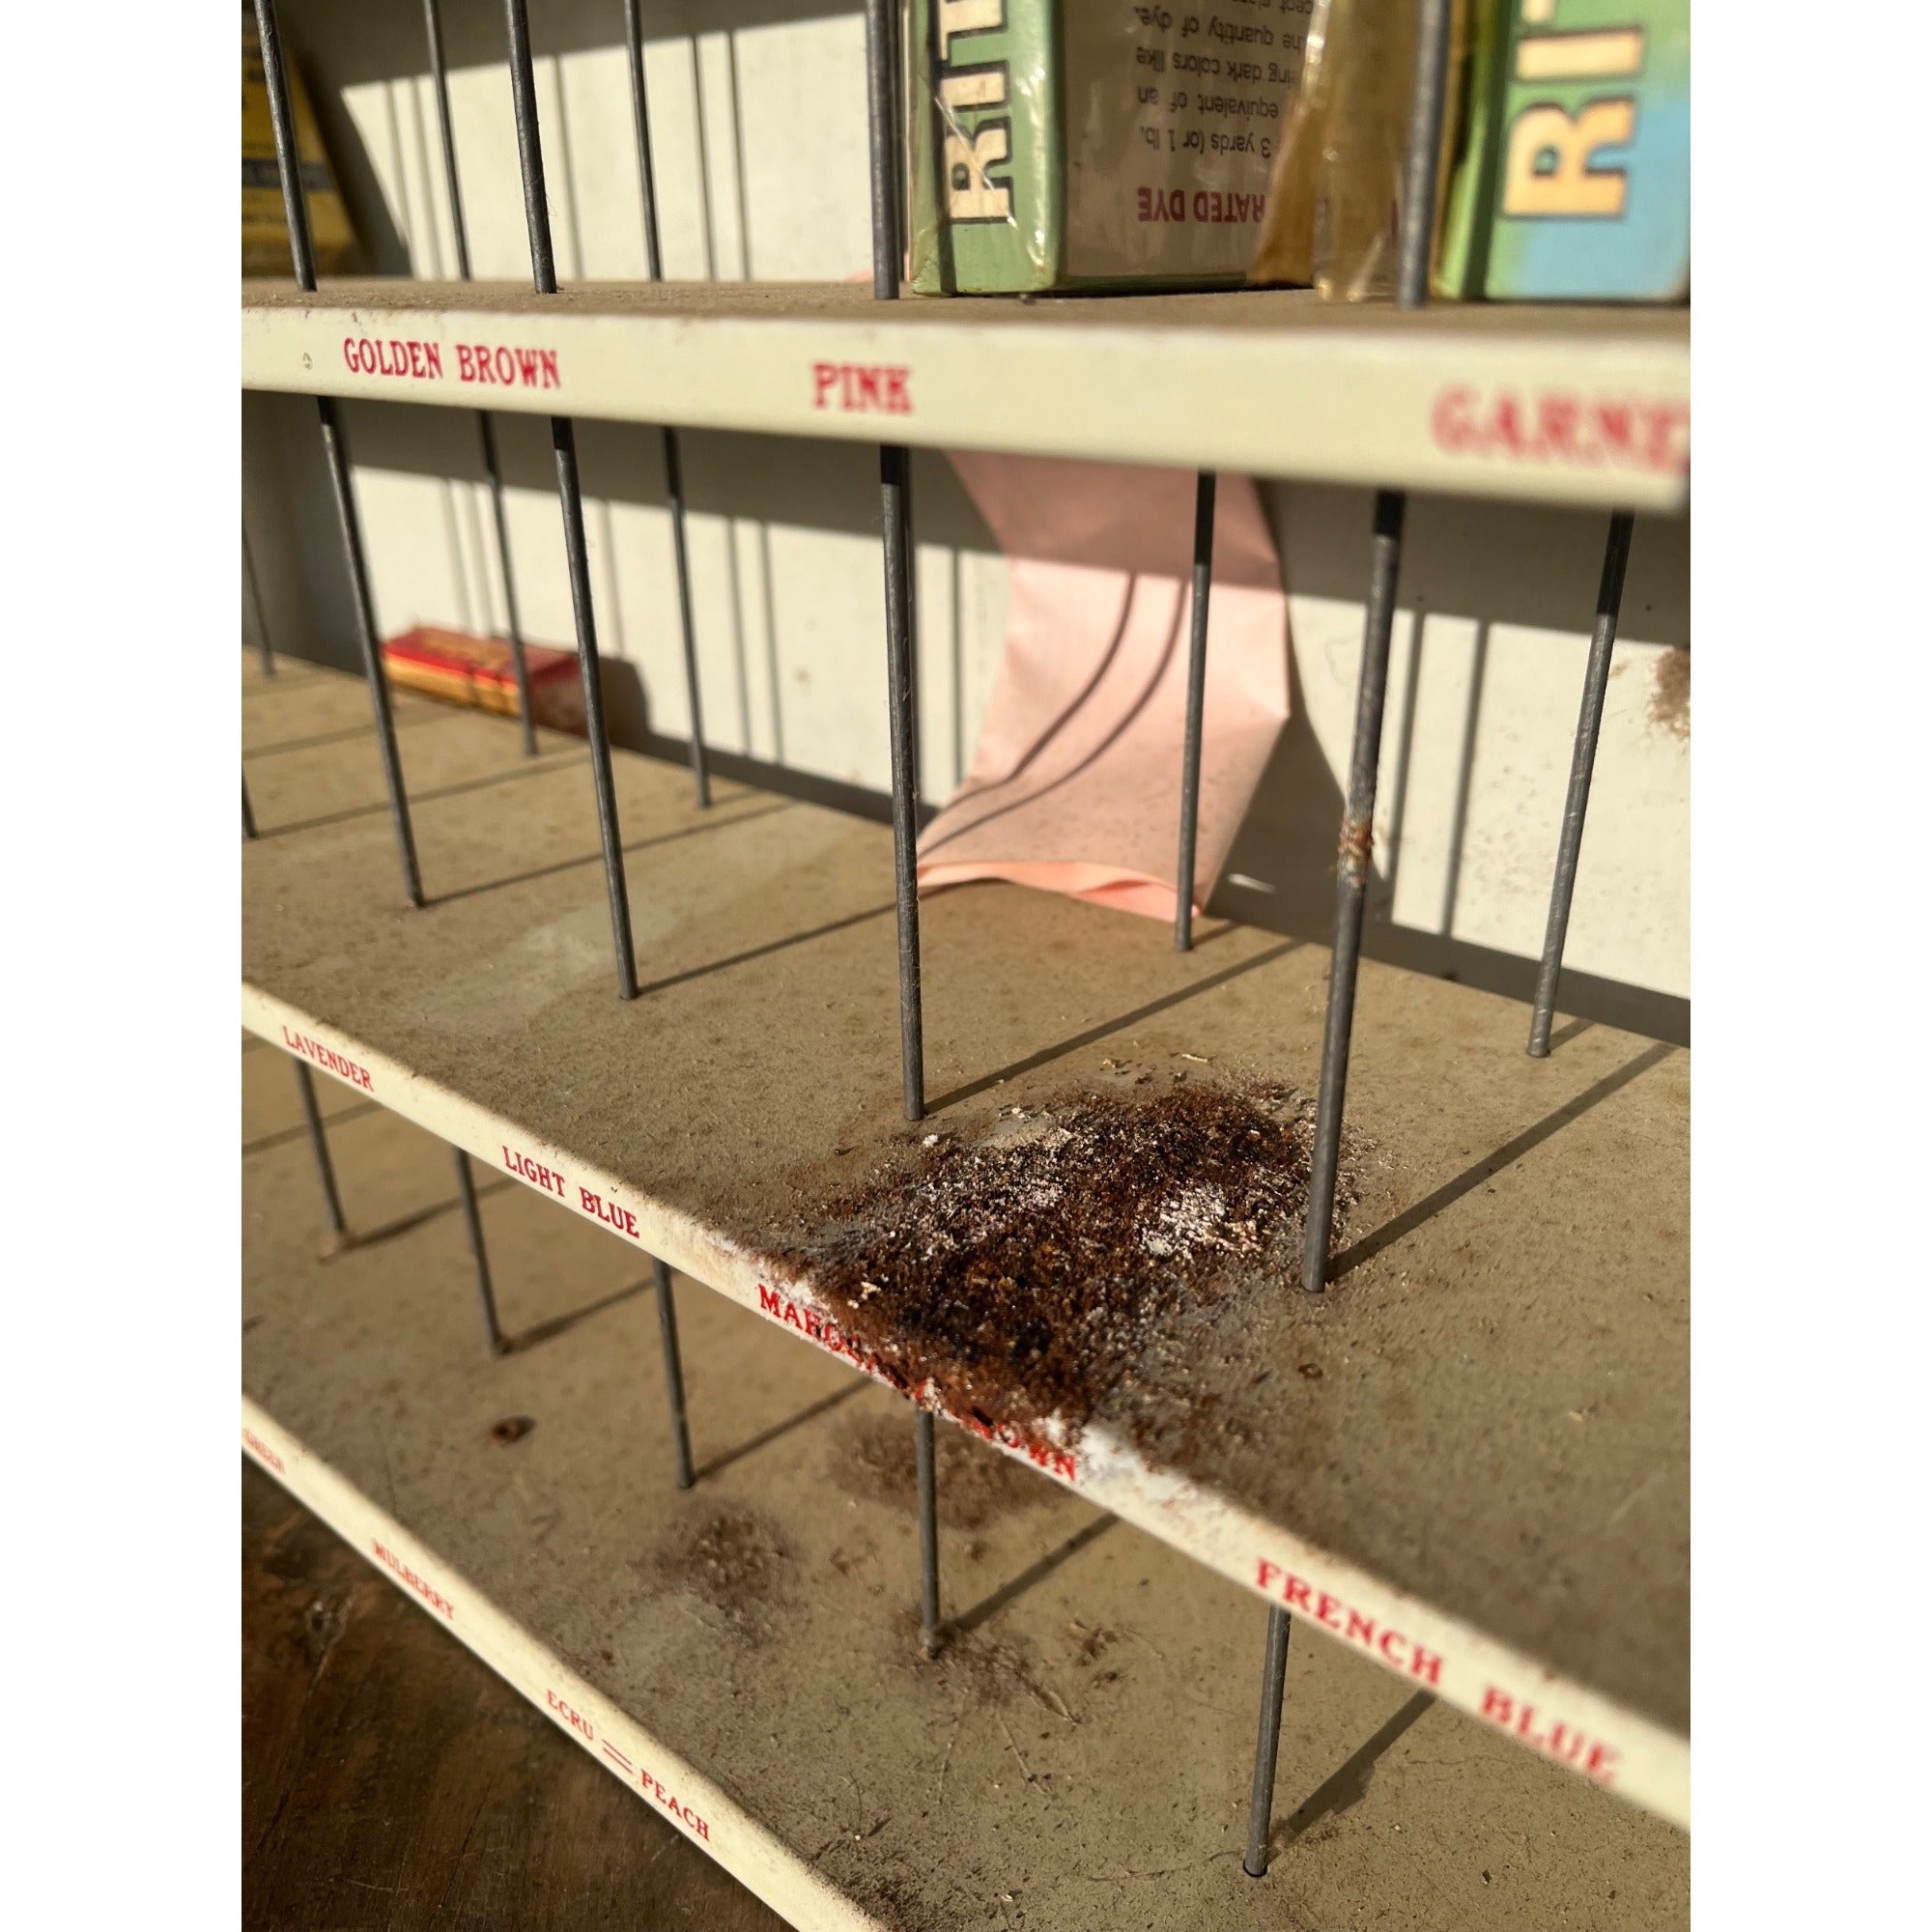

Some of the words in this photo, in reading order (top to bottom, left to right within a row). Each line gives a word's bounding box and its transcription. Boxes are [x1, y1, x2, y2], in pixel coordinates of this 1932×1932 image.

[1181, 15, 1200, 39] of
[1209, 15, 1274, 46] quantity
[1136, 46, 1166, 73] like
[1173, 51, 1221, 78] colors
[1227, 60, 1263, 84] dark
[1136, 85, 1159, 105] an
[1171, 91, 1188, 113] of
[1197, 93, 1279, 121] equivalent
[1500, 0, 1644, 220] RI
[1210, 131, 1255, 156] yards
[1260, 137, 1271, 159] 3
[1137, 185, 1186, 223] DYE
[1193, 189, 1266, 223] RATED
[343, 337, 444, 380] GOLDEN
[455, 344, 561, 389] BROWN
[811, 360, 914, 415] PINK
[282, 1024, 374, 1093] LAVENDER
[501, 1145, 565, 1197] LIGHT
[580, 1186, 639, 1239] BLUE
[371, 1538, 454, 1620] MULBERRY
[1255, 1556, 1446, 1687] FRENCH
[1480, 1685, 1621, 1784] BLUE
[546, 1689, 594, 1741] ECRU
[640, 1769, 711, 1842] PEACH
